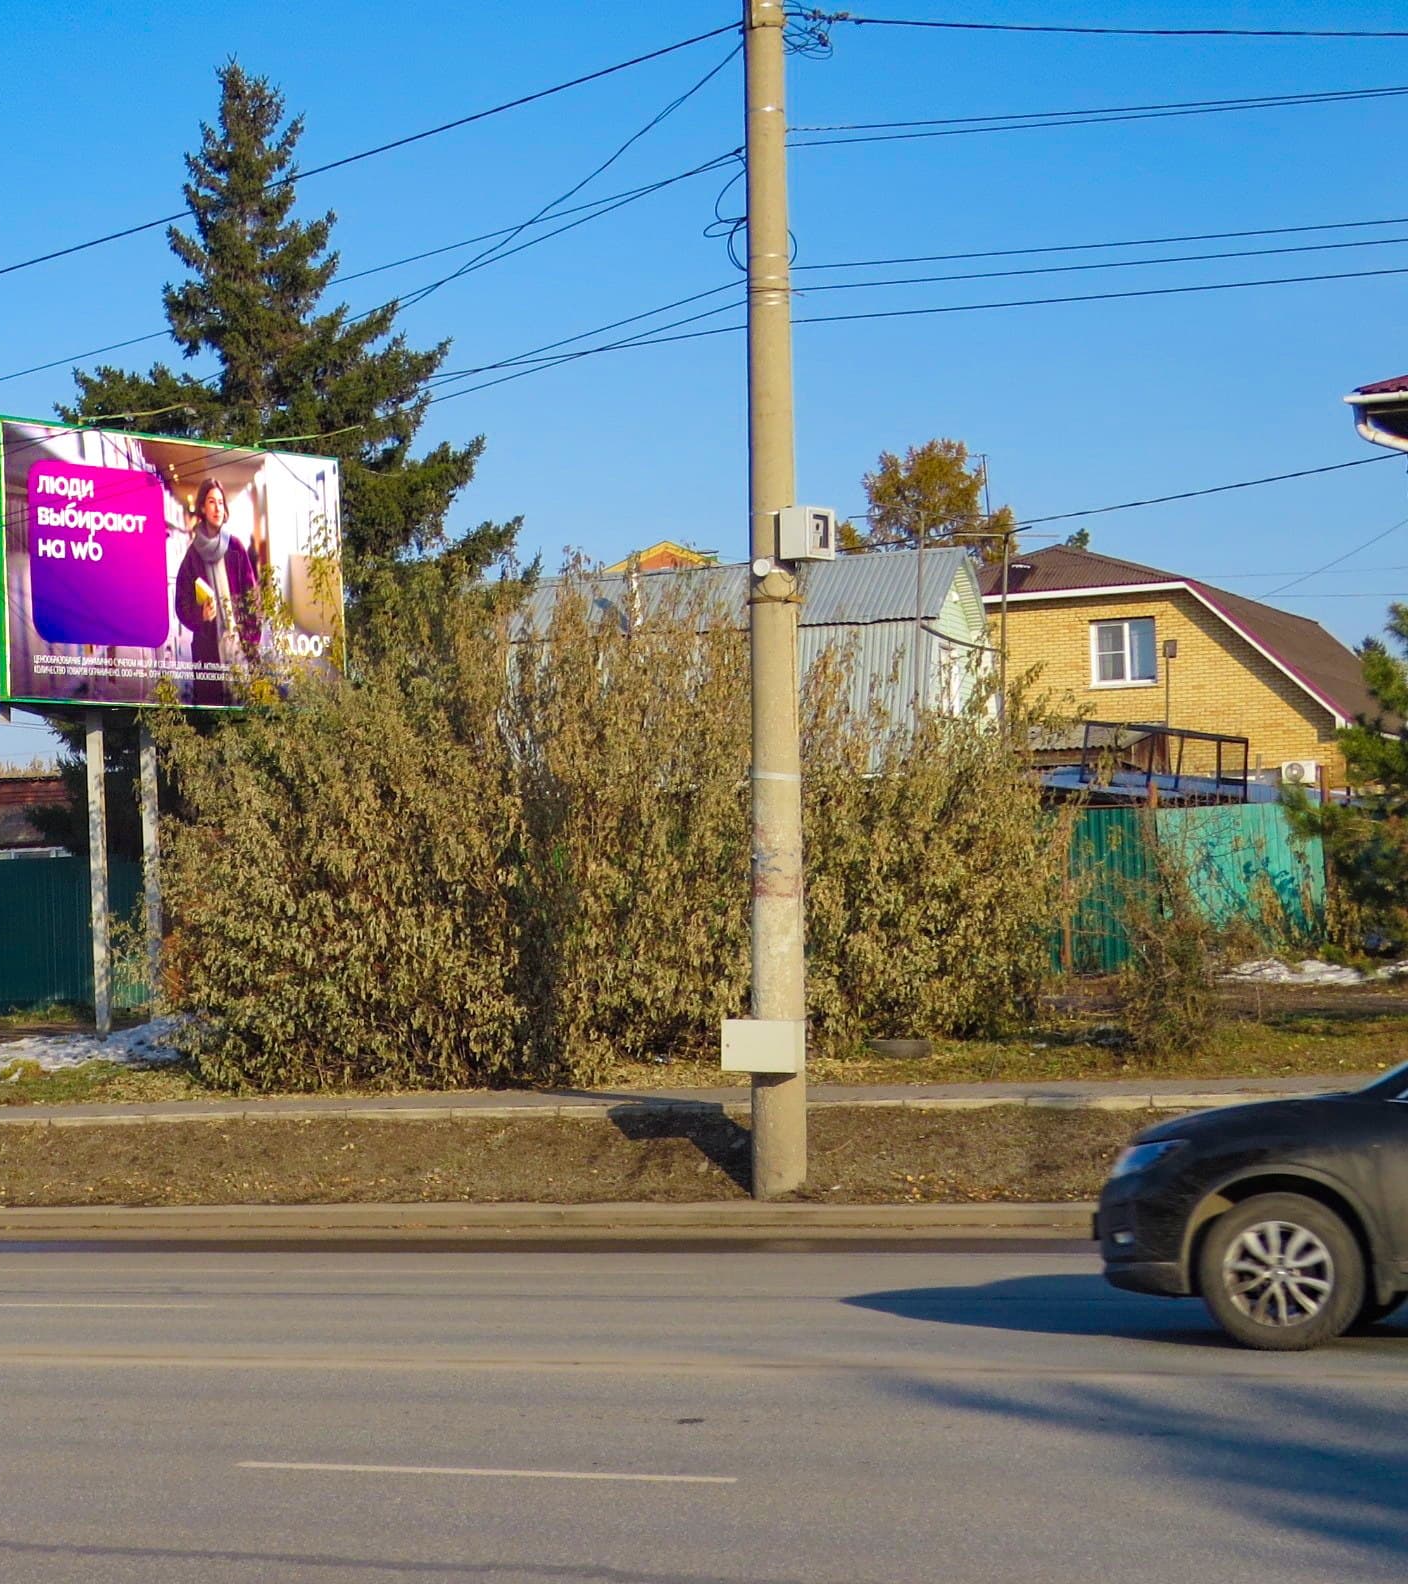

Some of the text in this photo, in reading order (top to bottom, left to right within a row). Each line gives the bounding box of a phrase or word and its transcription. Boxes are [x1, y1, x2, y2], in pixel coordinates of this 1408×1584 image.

[37, 475, 94, 501] люди
[37, 502, 147, 536] выбирают
[38, 534, 103, 562] на wb
